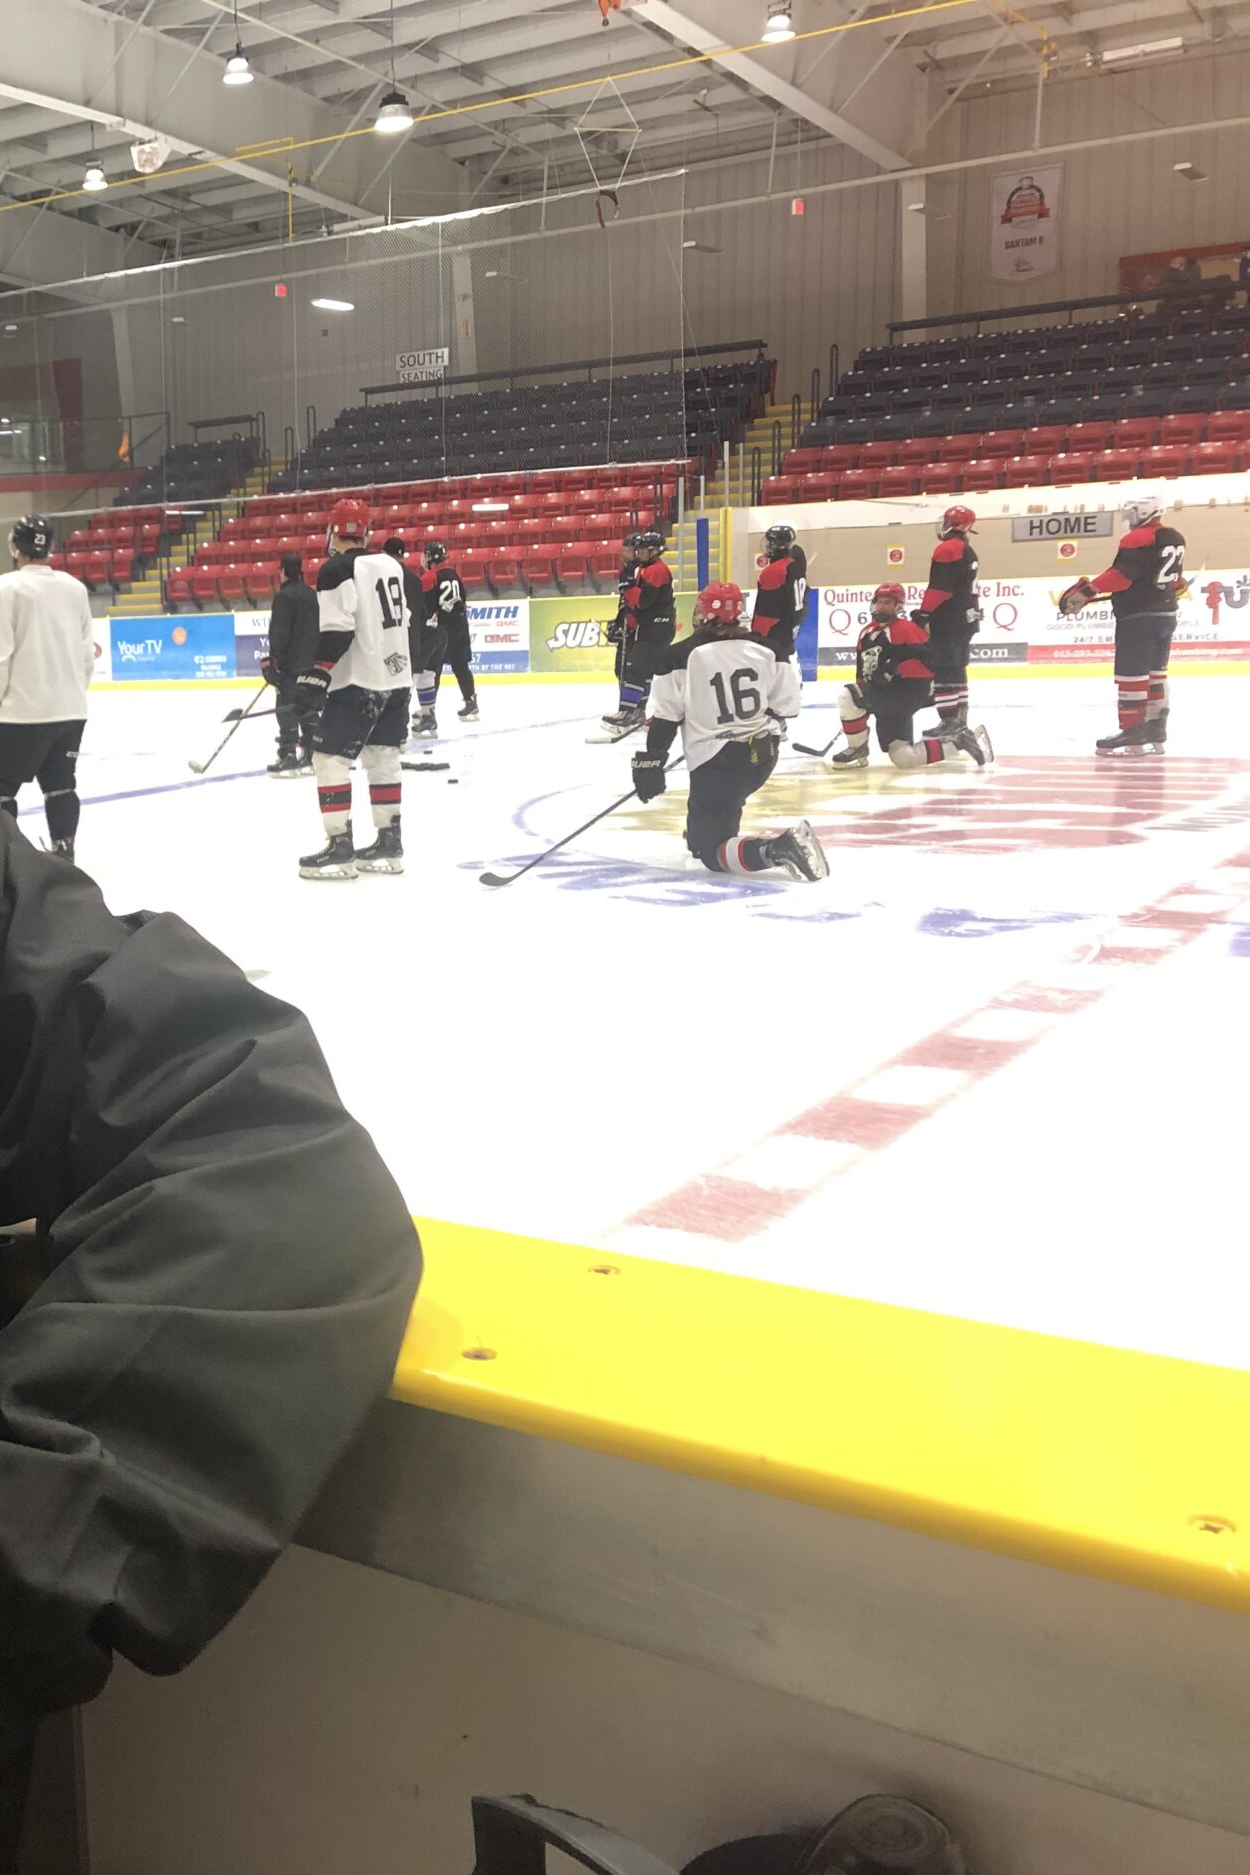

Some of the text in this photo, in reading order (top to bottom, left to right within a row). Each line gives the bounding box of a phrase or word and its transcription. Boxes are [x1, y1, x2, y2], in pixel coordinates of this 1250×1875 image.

[399, 351, 444, 369] SOUTH
[401, 368, 443, 382] SEATING
[1028, 515, 1097, 537] HOME
[34, 533, 46, 545] 23
[824, 588, 872, 607] Quinte
[907, 585, 927, 601] Re
[996, 581, 1025, 597] Inc.
[828, 608, 851, 636] Q
[992, 602, 1018, 632] Q
[1056, 610, 1117, 622] PLUMBI
[709, 667, 761, 725] 16
